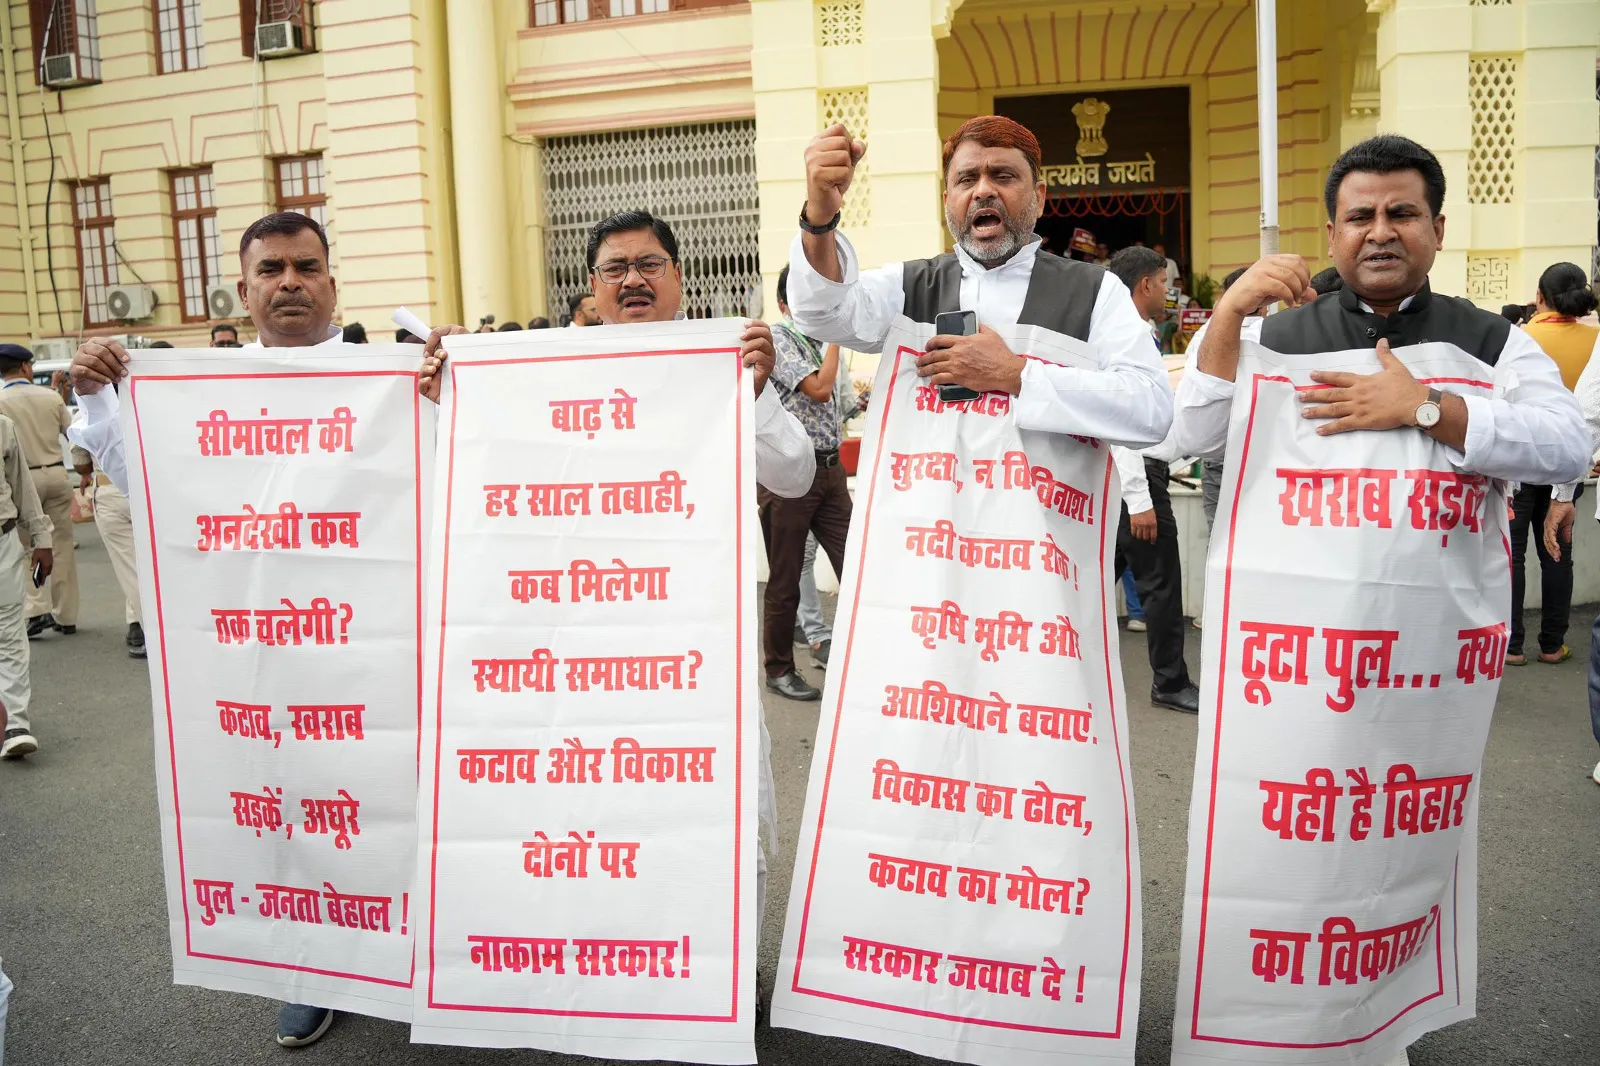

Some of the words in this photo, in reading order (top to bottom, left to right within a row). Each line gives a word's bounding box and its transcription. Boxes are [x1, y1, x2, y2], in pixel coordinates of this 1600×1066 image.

[1106, 152, 1156, 184] जयते
[195, 408, 313, 457] सीमांचल
[317, 406, 357, 453] की
[549, 398, 604, 440] बाढ़
[609, 388, 638, 430] से
[483, 484, 521, 517] हर
[525, 482, 594, 517] साल
[598, 470, 695, 519] तबाही,
[973, 459, 997, 489] न
[1276, 468, 1398, 529] खराब
[196, 502, 304, 552] अनदेखी
[307, 511, 362, 549] कब
[905, 519, 957, 561] नदी
[958, 535, 1035, 571] कटाव
[508, 569, 564, 604] कब
[568, 558, 671, 603] मिलेगा
[211, 608, 252, 645] तक
[254, 596, 354, 646] चलेगी?
[910, 599, 969, 650] कृषि
[974, 610, 1034, 663] भूमि
[471, 647, 560, 693] स्थायी
[563, 649, 704, 692] समाधान?
[1240, 620, 1315, 707] टूटा
[1455, 621, 1508, 685] क्या
[215, 700, 282, 749] कटाव,
[287, 703, 367, 741] खराब
[881, 679, 1011, 734] आशियाने
[457, 748, 541, 784] कटाव
[546, 737, 606, 784] और
[610, 737, 717, 783] विकास
[230, 785, 294, 841] सड़कें,
[300, 789, 361, 852] अधूरे
[872, 758, 971, 813] विकास
[974, 782, 1018, 820] का
[1022, 780, 1093, 837] ढोल,
[1259, 767, 1345, 843] यही
[1344, 765, 1379, 842] है
[1383, 763, 1473, 840] बिहार
[522, 830, 596, 879] दोनों
[597, 842, 641, 879] पर
[193, 878, 235, 927] पुल
[255, 883, 323, 925] जनता
[868, 852, 953, 898] कटाव
[956, 866, 1002, 905] का
[1005, 865, 1091, 916] मोल?
[467, 934, 567, 975] नाकाम
[571, 935, 691, 979] सरकार!
[842, 935, 943, 985] सरकार
[946, 953, 1038, 998] जवाब
[1249, 928, 1313, 985] का
